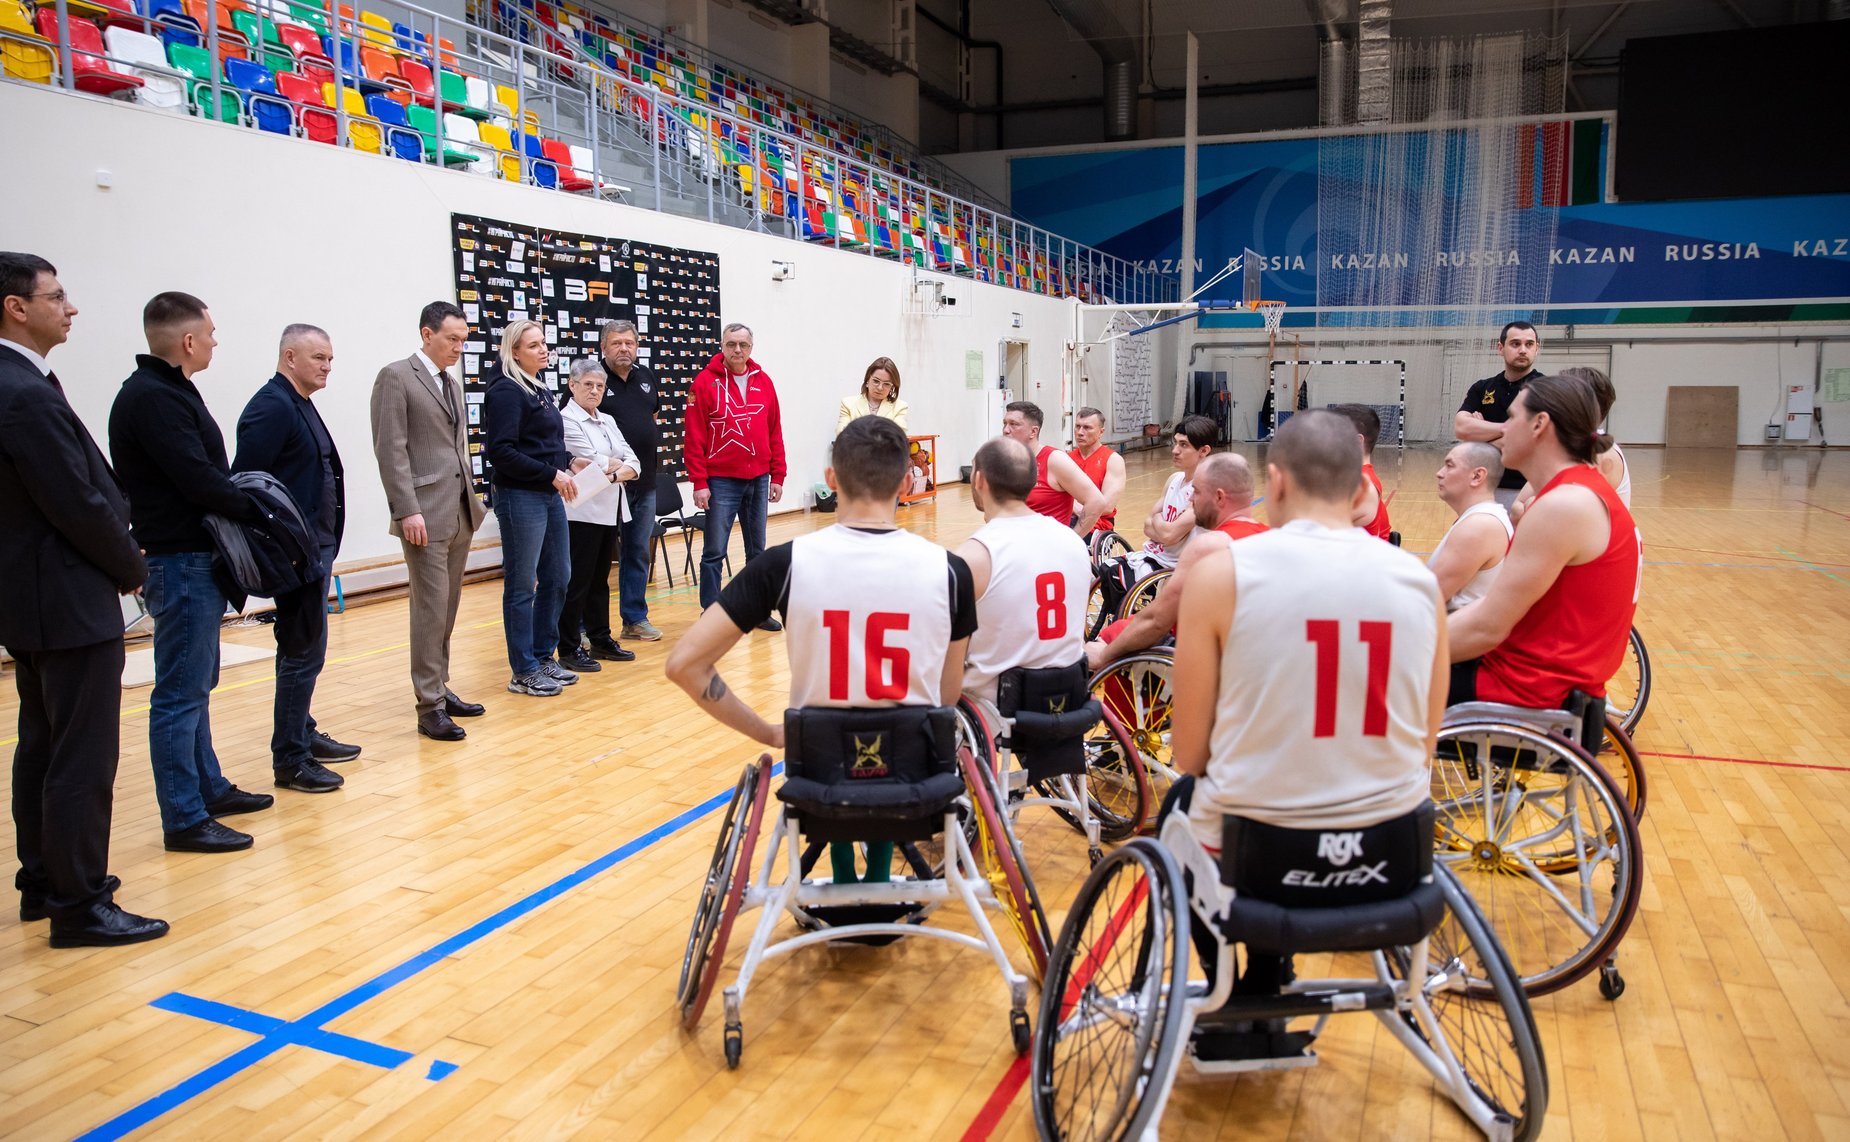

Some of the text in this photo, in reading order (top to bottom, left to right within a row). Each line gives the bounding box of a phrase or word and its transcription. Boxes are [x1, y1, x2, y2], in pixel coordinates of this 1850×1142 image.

[1228, 256, 1306, 271] RSSIA
[1332, 253, 1408, 269] KAZAN
[1436, 250, 1521, 267] RUSSIA
[1549, 246, 1635, 265] KAZAN
[1665, 242, 1760, 261] RUSSIA
[565, 279, 628, 305] BFL
[1035, 572, 1067, 640] 8
[823, 610, 910, 700] 16
[1306, 620, 1392, 738] 11
